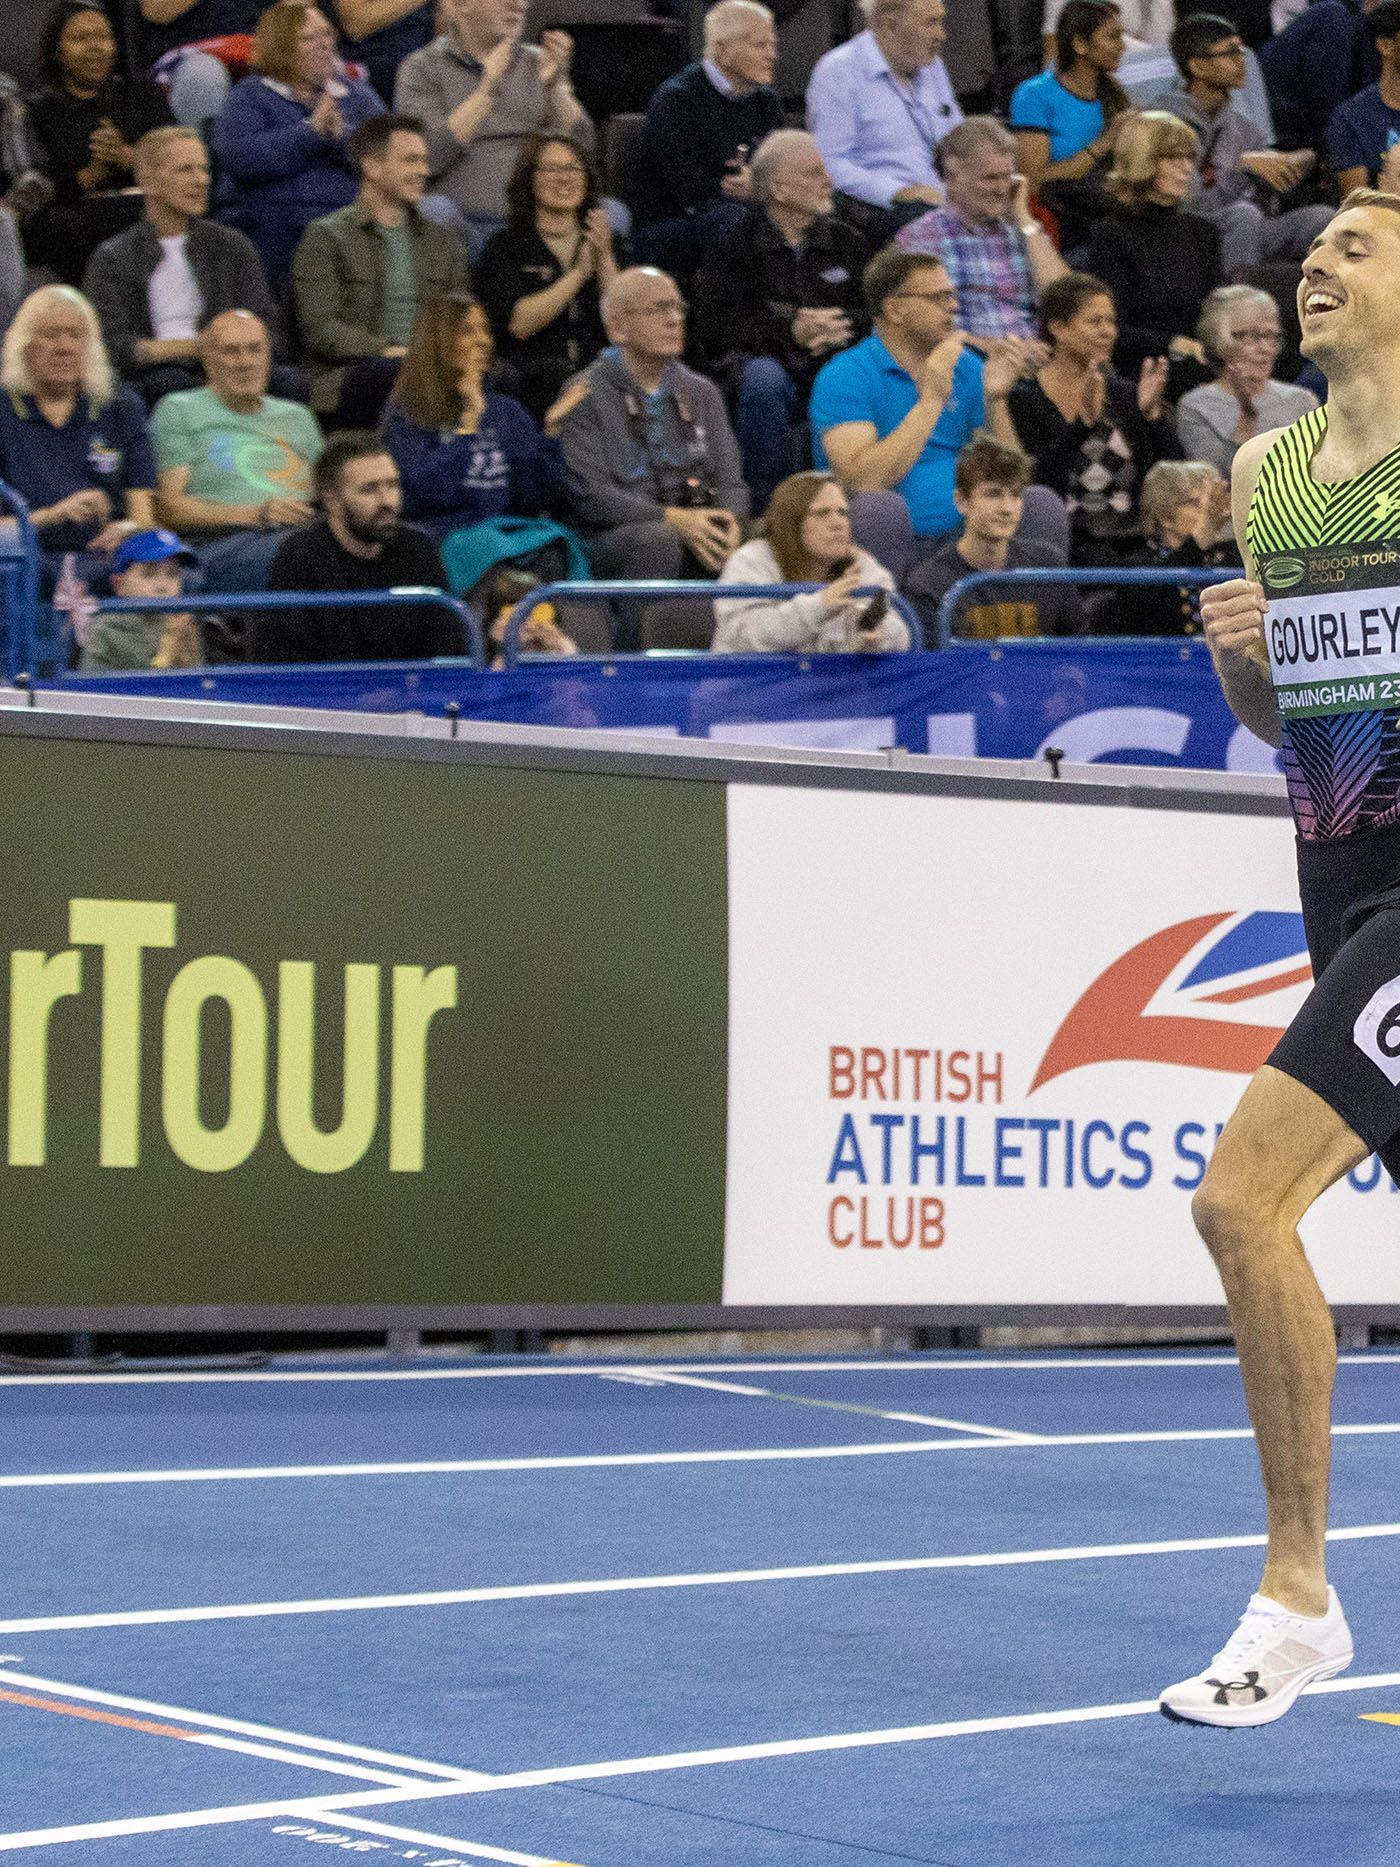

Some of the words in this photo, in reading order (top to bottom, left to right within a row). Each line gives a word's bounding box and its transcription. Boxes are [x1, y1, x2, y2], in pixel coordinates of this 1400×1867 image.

[1309, 555, 1359, 572] INDOOR
[1362, 551, 1397, 566] TOUR
[1309, 570, 1345, 585] GOLD
[1277, 682, 1375, 710] BIRMINGHAM
[829, 1046, 1003, 1104] BRITISH
[825, 1113, 1153, 1190] ATHLETICS
[827, 1195, 946, 1250] CLUB
